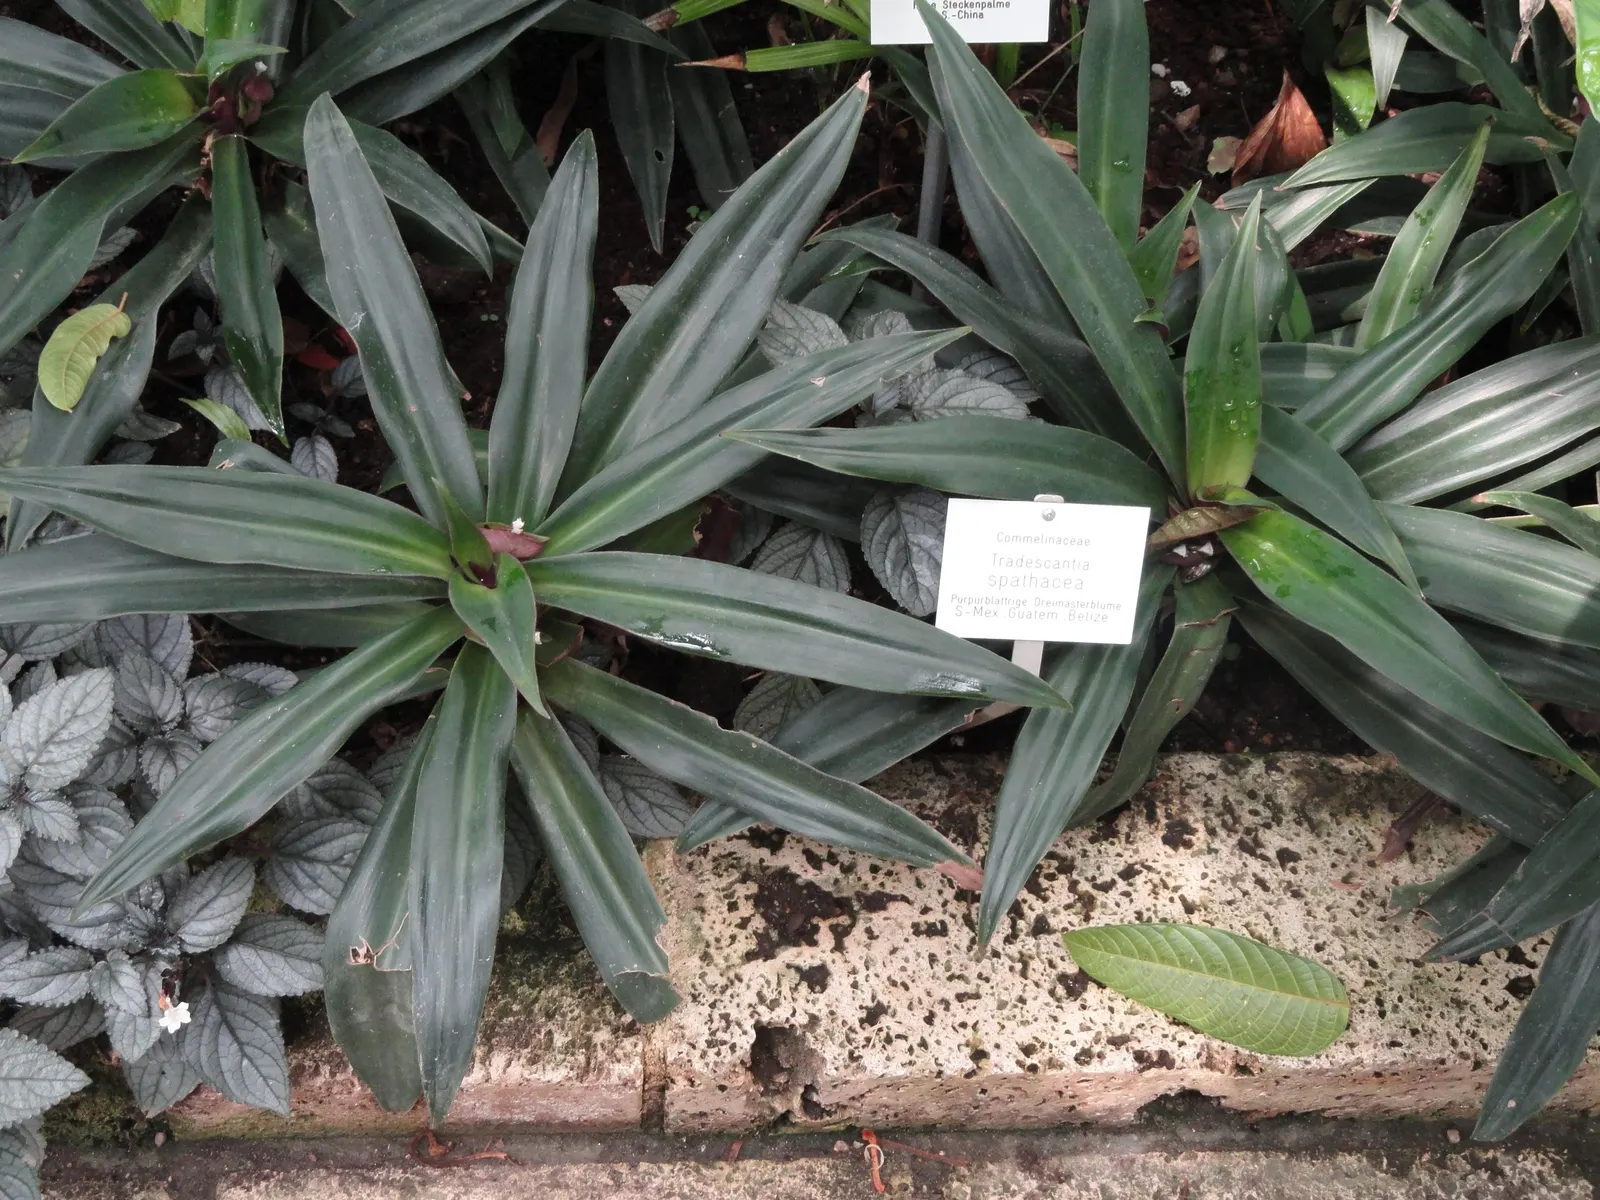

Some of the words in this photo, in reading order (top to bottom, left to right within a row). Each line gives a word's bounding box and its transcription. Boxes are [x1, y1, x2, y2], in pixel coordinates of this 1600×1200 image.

[942, 0, 1011, 10] Steckenpalme
[996, 531, 1091, 547] Commelinaceae
[991, 552, 1090, 571] Tradescantia
[987, 572, 1084, 591] spathacea
[1033, 596, 1122, 611] Dreimasterblume
